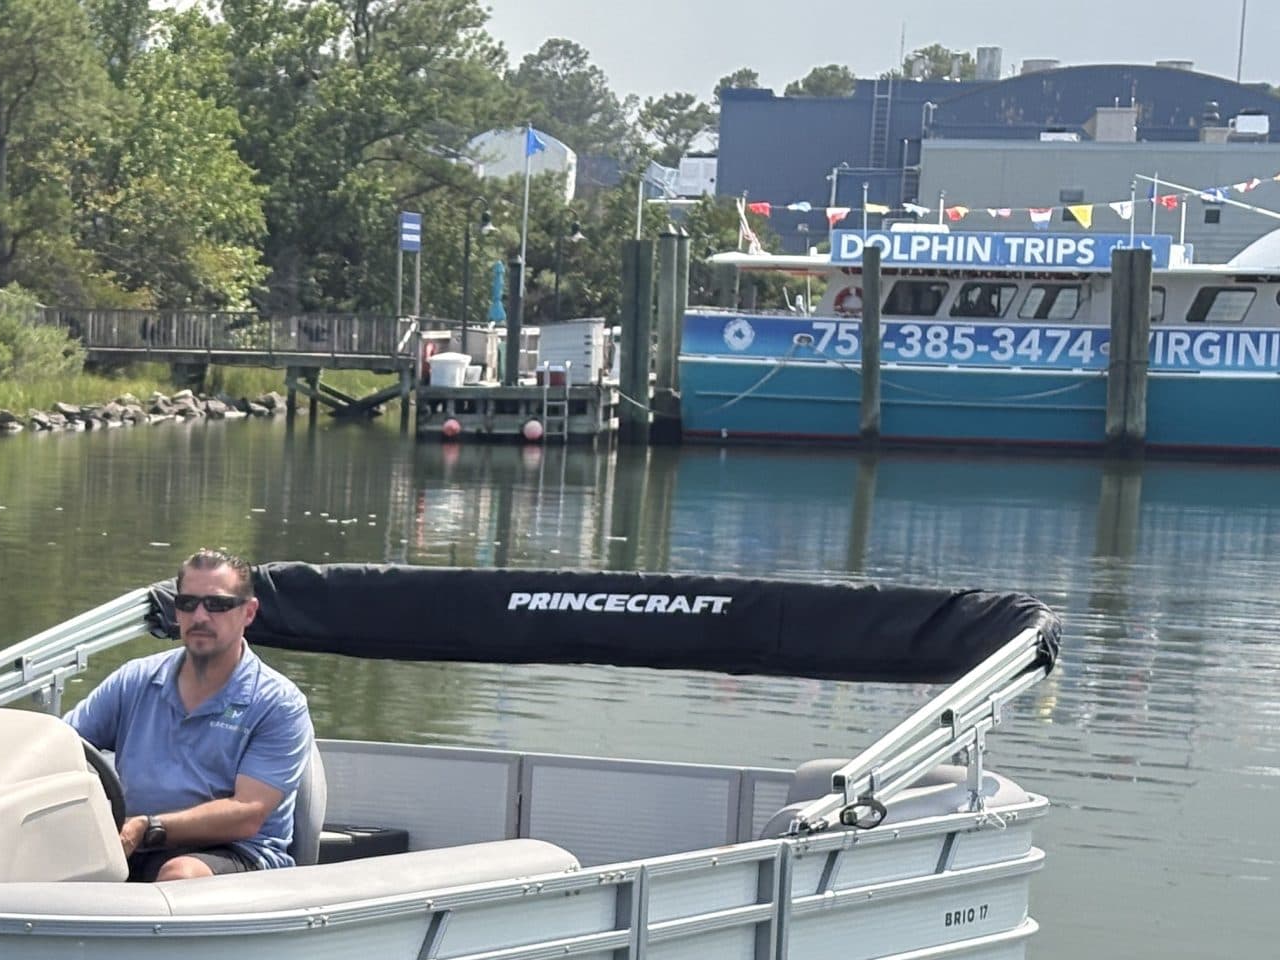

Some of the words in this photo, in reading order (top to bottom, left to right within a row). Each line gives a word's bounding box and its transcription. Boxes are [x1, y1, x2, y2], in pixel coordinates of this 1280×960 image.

[840, 234, 992, 262] DOLPHIN
[1004, 237, 1095, 265] TRIPS
[812, 322, 1095, 364] 75-385-3474
[1147, 331, 1280, 366] IRGINI
[507, 592, 732, 614] PRINCECRAFT
[945, 908, 975, 927] BRIO
[980, 904, 988, 920] 17
